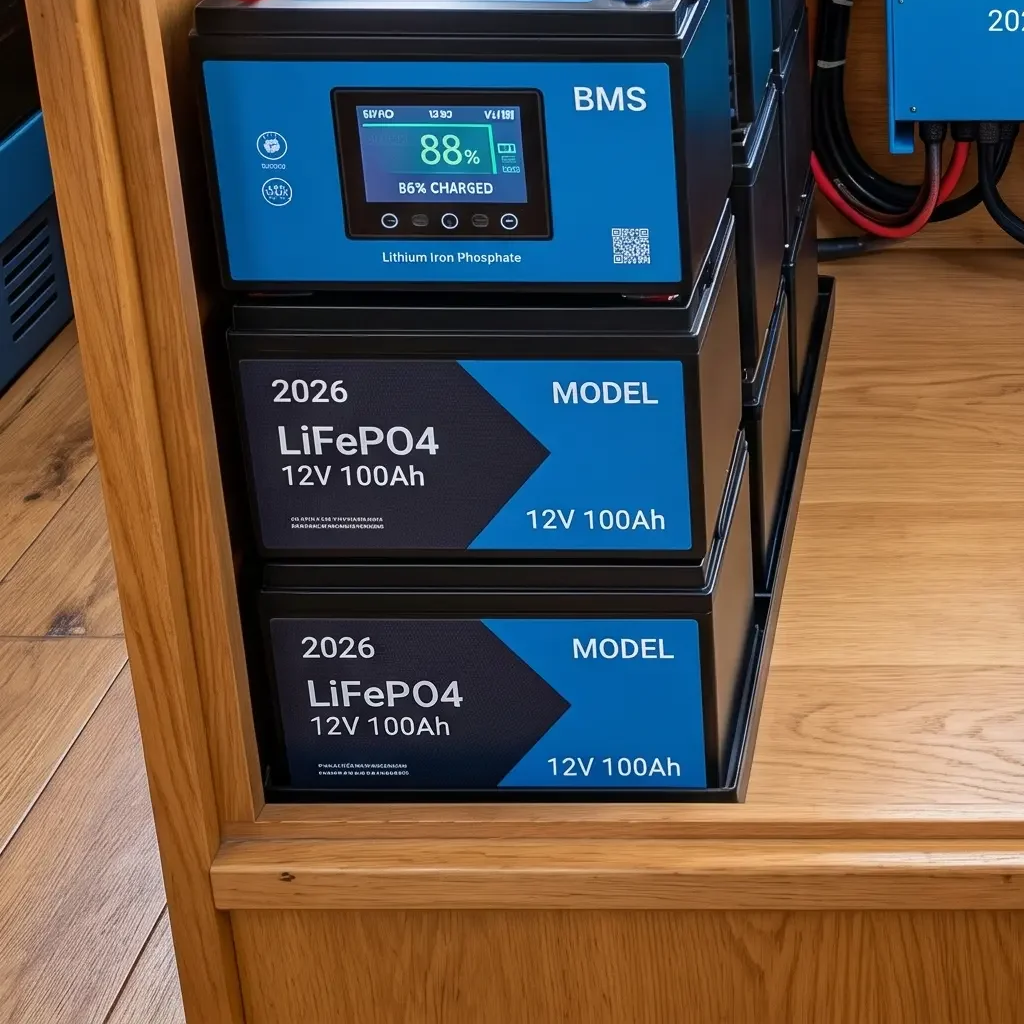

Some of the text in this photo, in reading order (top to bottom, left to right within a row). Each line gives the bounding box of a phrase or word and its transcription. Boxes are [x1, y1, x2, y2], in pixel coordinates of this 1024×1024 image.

[573, 86, 647, 112] BMS
[430, 182, 493, 194] CHARGED
[382, 252, 522, 264] Lithium Iron Phosphate
[271, 379, 348, 403] 2026
[551, 381, 659, 405] MODEL
[277, 425, 439, 456] LiFePO4
[281, 465, 425, 487] 12V 100Ah
[526, 509, 666, 531] 12V 100Ah
[301, 636, 375, 659] 2026
[572, 637, 674, 659] MODEL
[307, 679, 463, 709] LiFePO4
[310, 716, 450, 737] 12V 100Ah
[547, 757, 681, 778] 12V 100Ah
